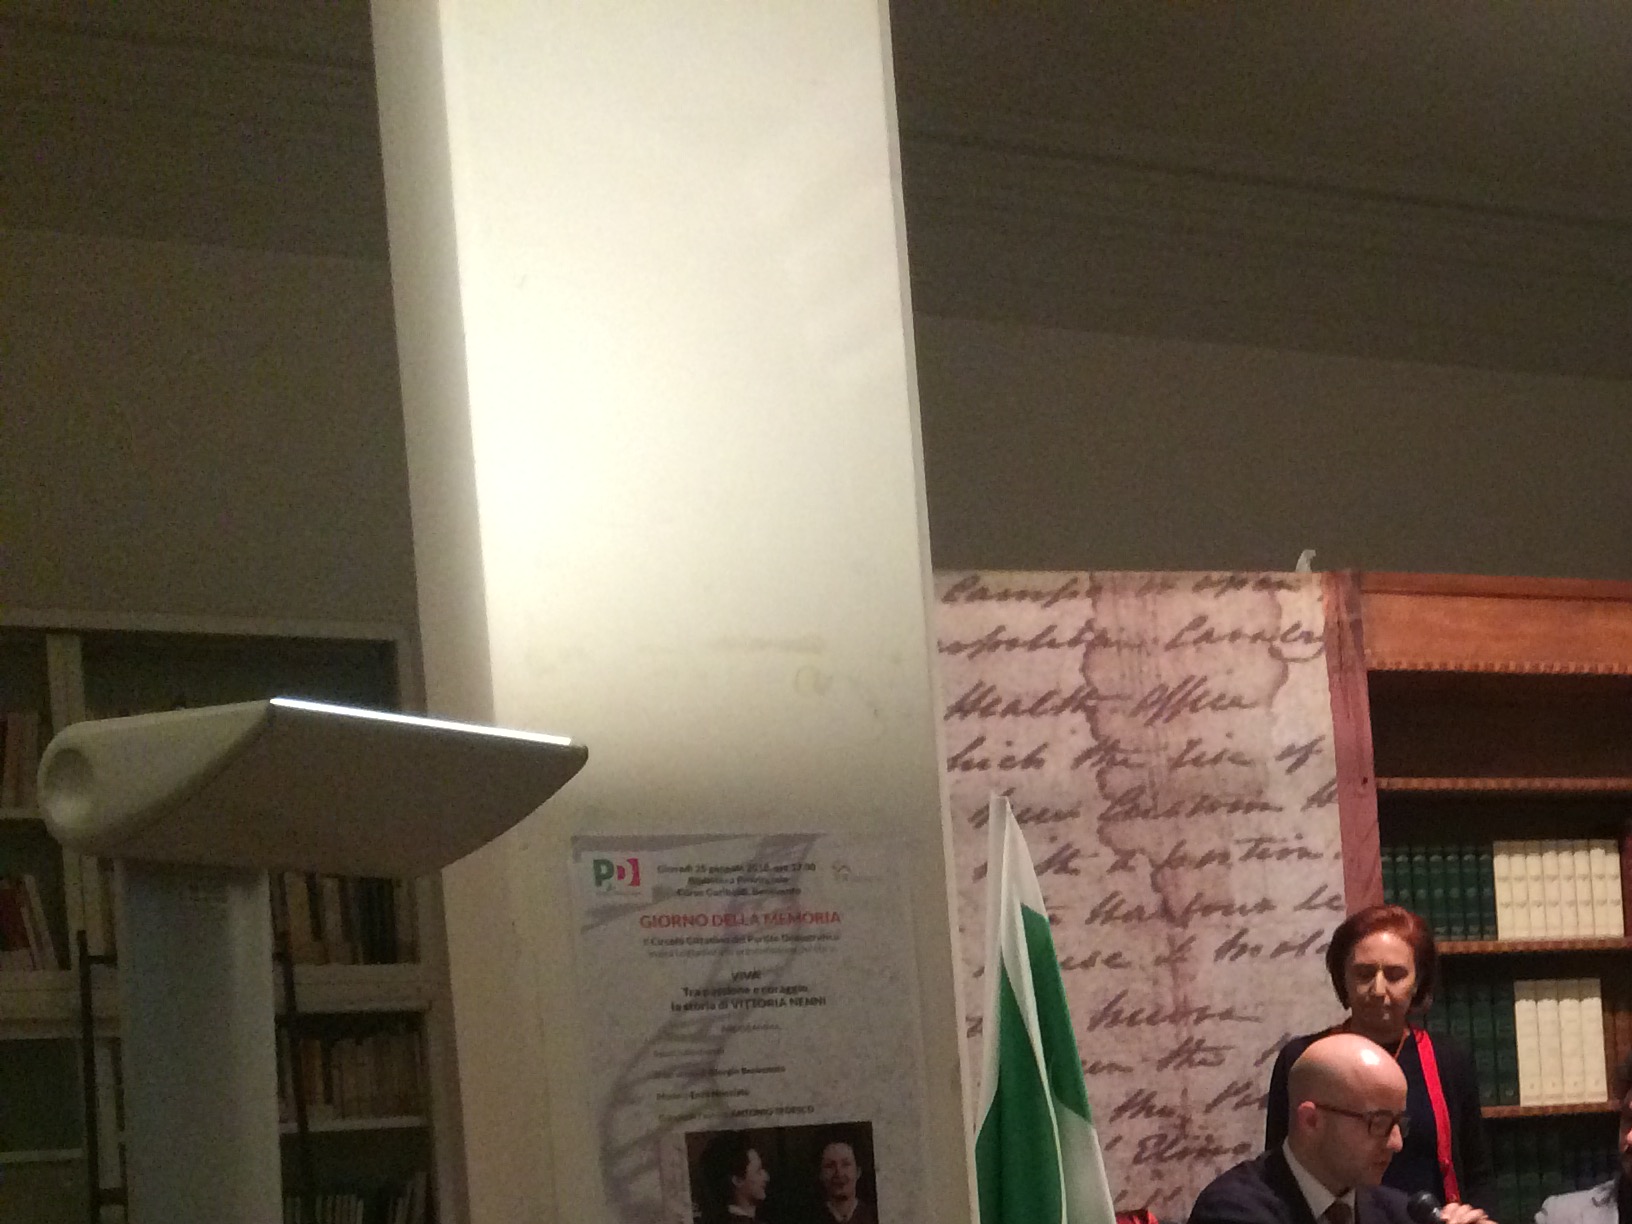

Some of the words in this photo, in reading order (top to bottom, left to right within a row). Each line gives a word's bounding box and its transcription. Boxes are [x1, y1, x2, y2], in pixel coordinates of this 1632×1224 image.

[639, 913, 709, 930] GIORNO
[711, 913, 759, 928] DELLA
[763, 911, 842, 927] MEMORIA
